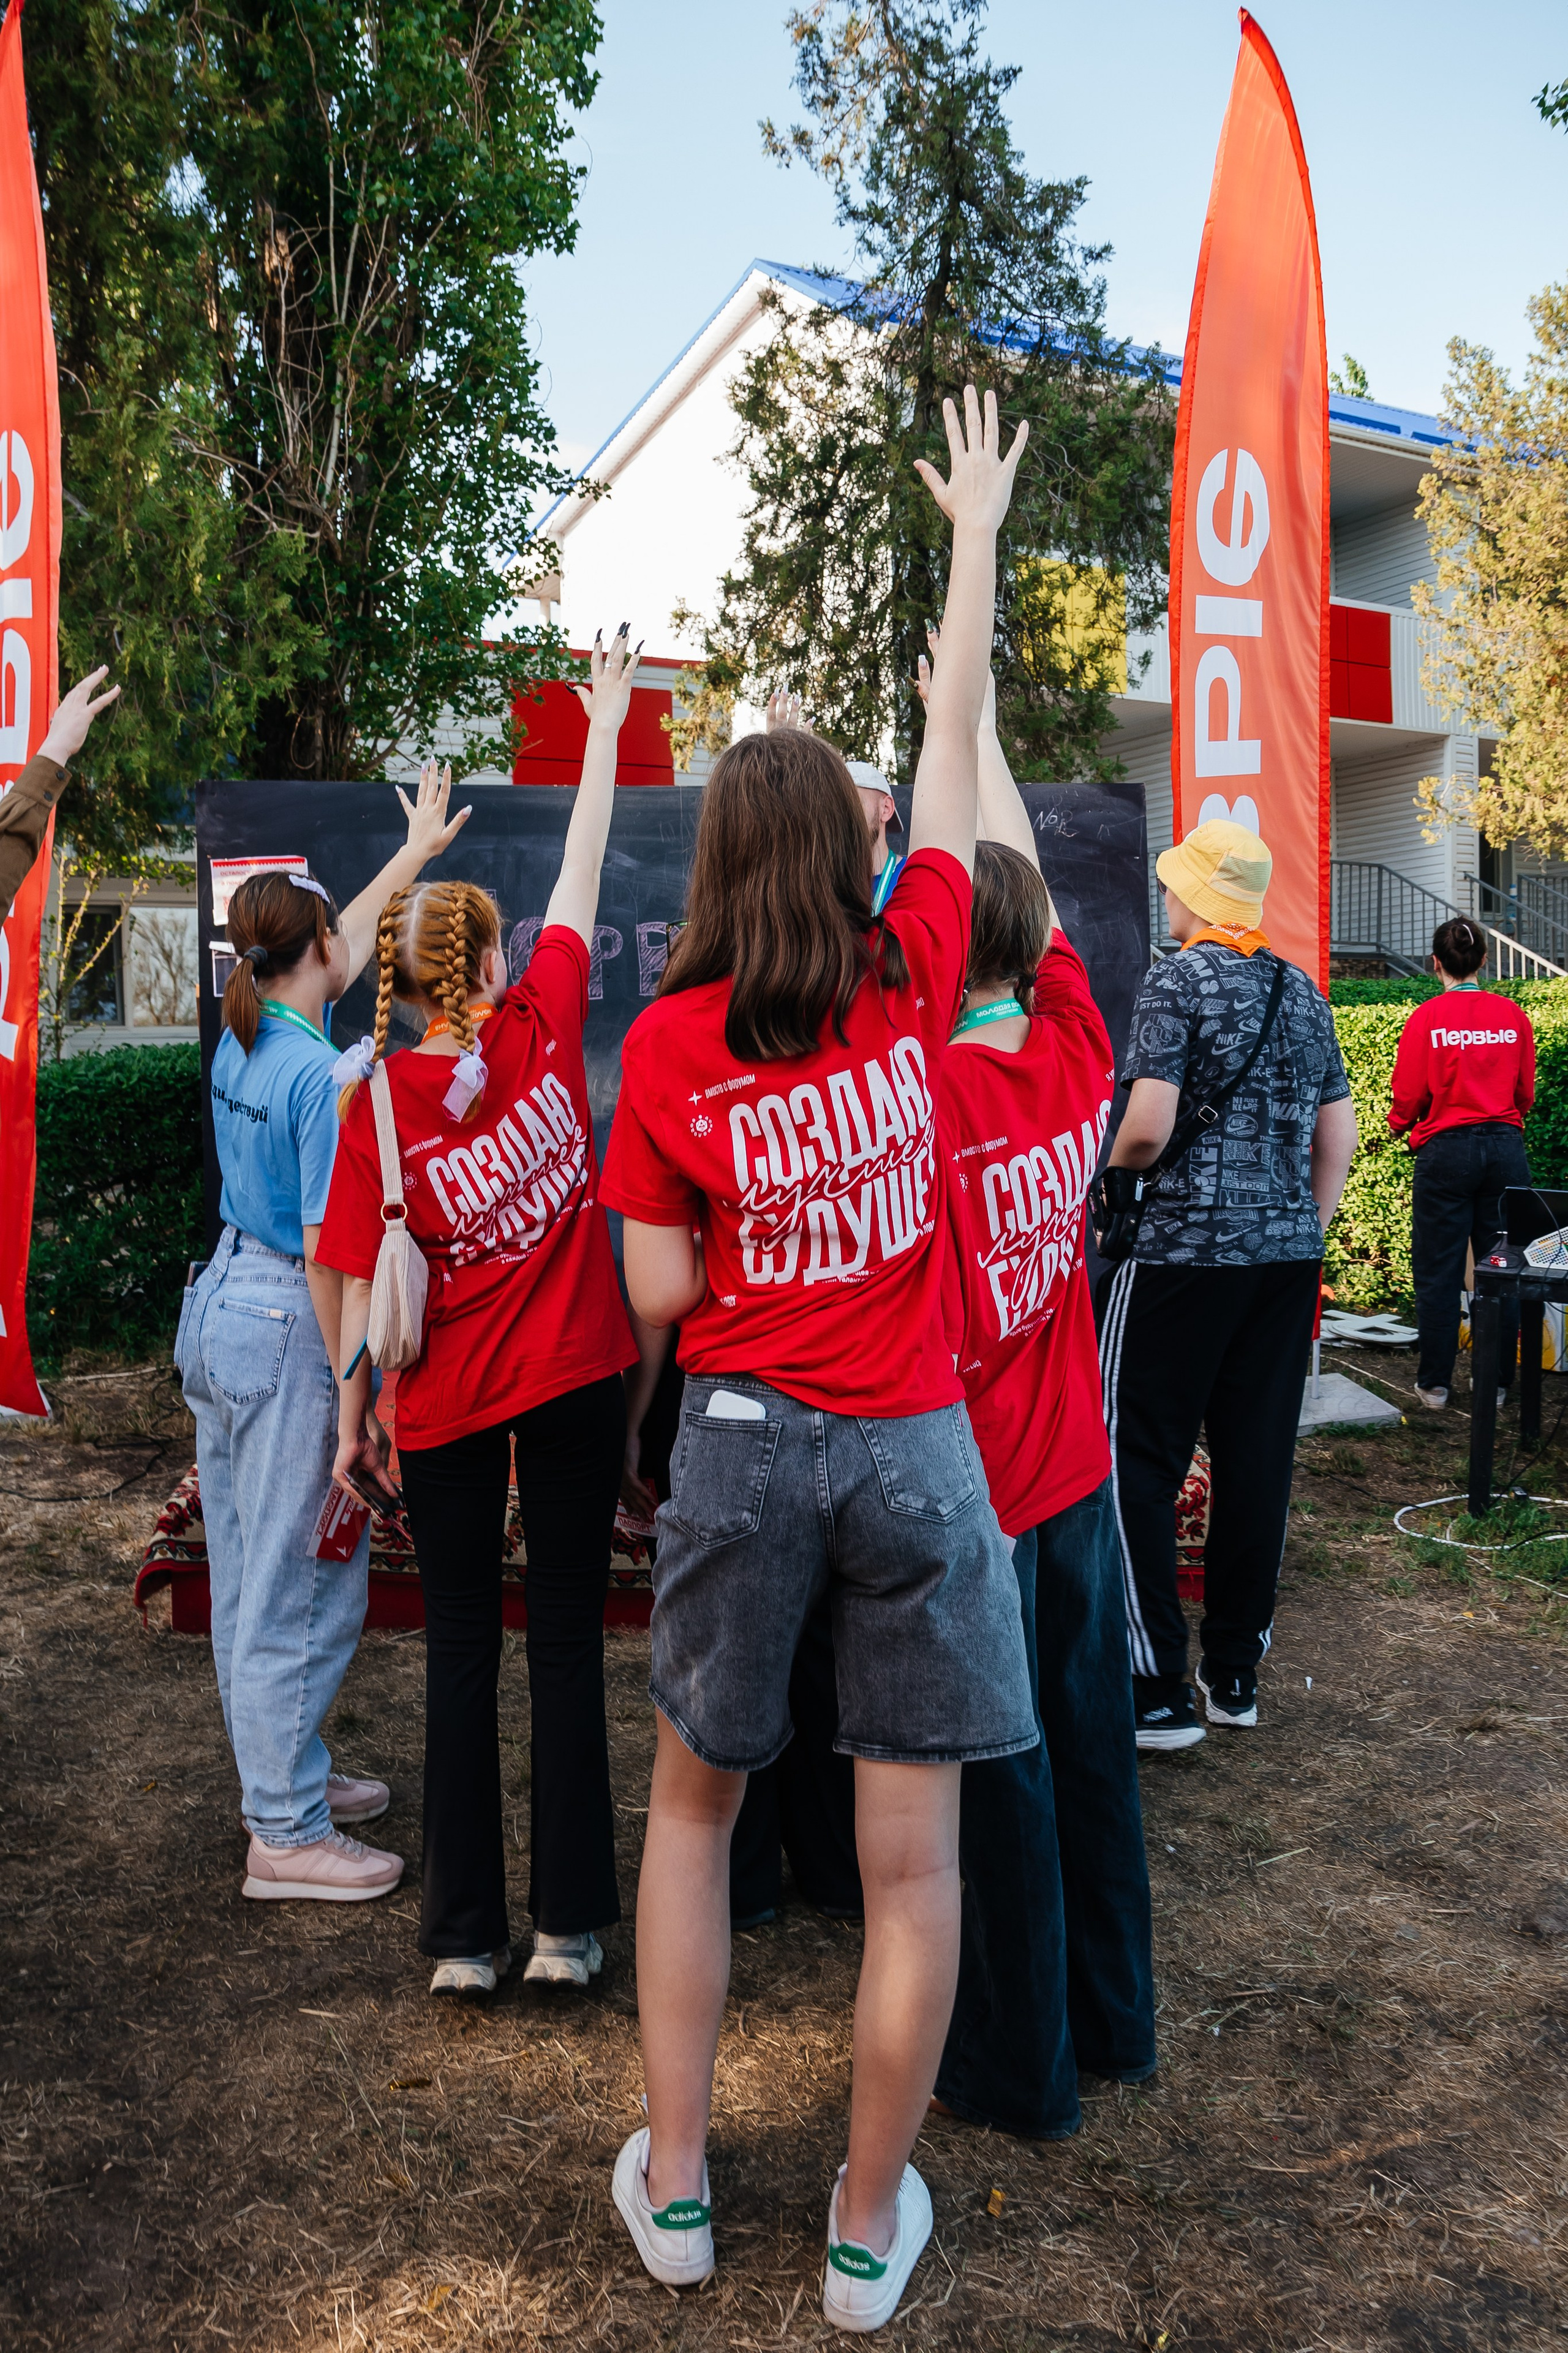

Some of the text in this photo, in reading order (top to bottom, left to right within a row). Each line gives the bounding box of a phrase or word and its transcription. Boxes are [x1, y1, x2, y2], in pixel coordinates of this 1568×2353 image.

[1215, 1032, 1245, 1045] NIKE
[1430, 1027, 1518, 1051] Первые
[723, 1082, 728, 1092] с
[727, 1073, 756, 1092] форумом
[729, 1036, 932, 1195] СОЗДАЮ
[1231, 1118, 1248, 1127] NIKE
[426, 1072, 576, 1225] СОЗДАЮ
[985, 1136, 1008, 1153] форумом
[1223, 1139, 1271, 1166] NIKE
[1222, 1169, 1239, 1180] NIKE
[668, 2208, 702, 2223] adidas
[837, 2253, 870, 2272] adidas
